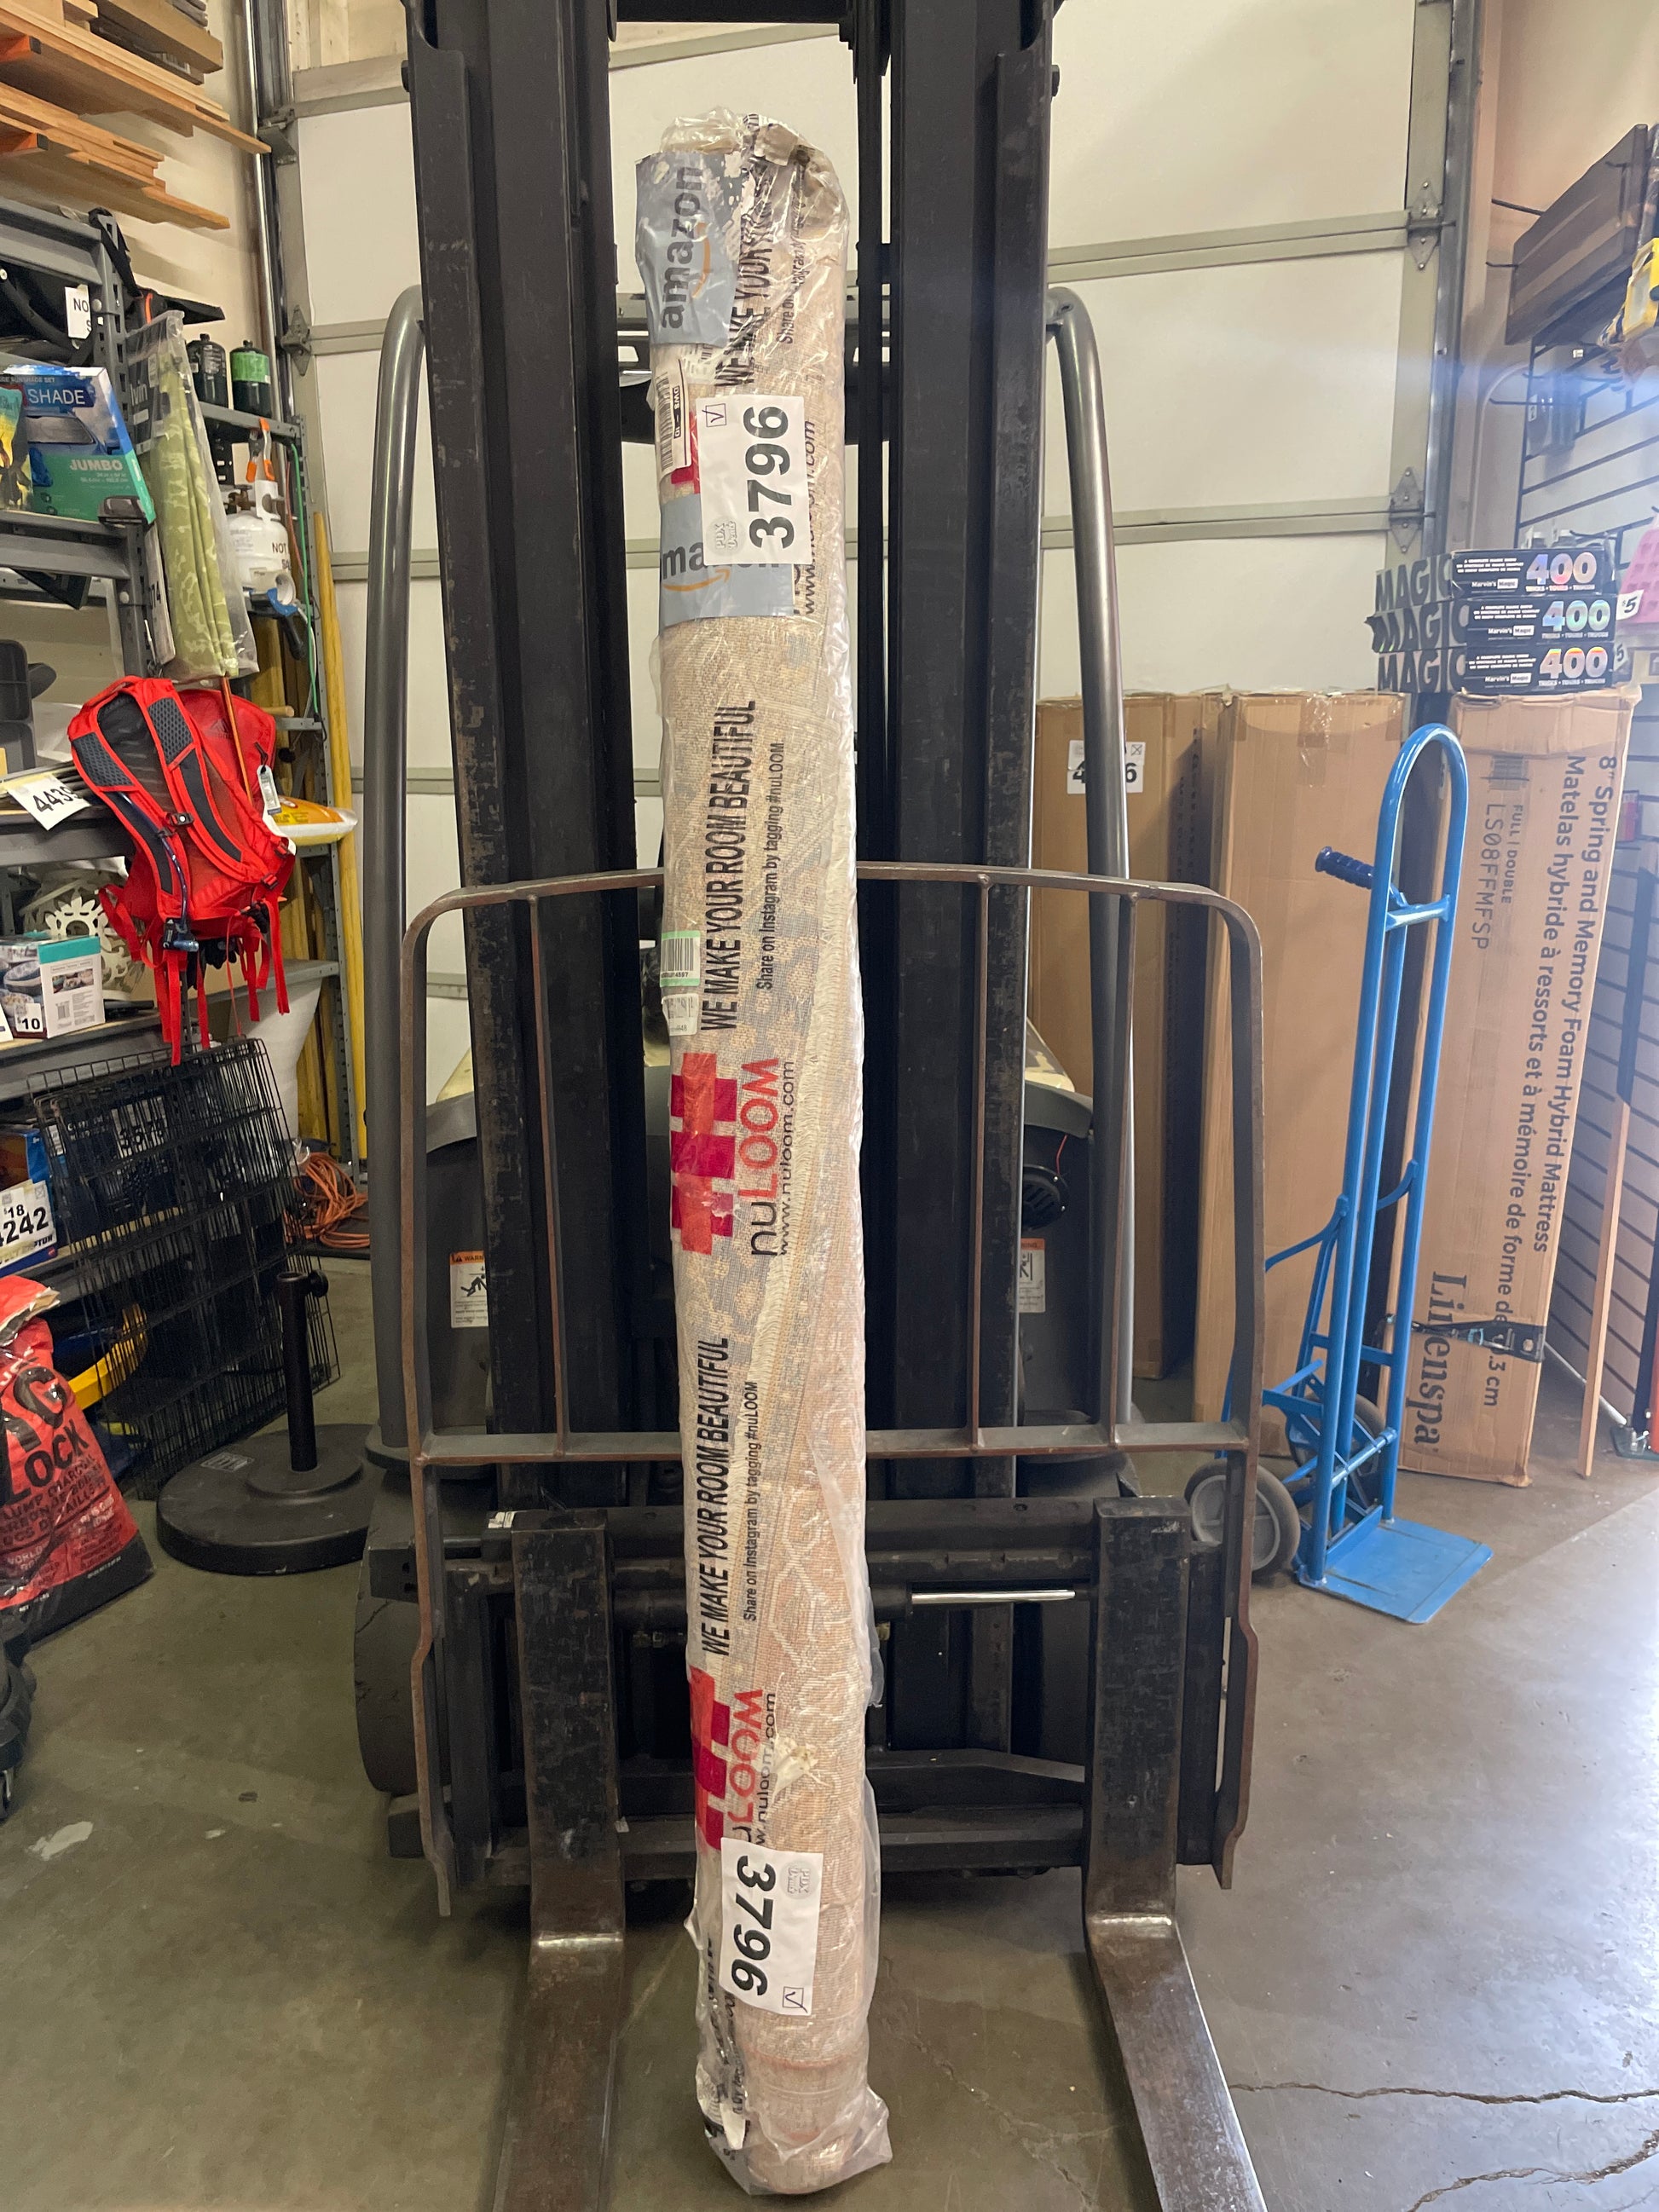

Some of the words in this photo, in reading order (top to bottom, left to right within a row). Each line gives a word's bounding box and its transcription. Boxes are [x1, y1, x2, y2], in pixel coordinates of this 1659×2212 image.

[662, 166, 703, 330] amazon
[28, 389, 85, 405] SHADE
[70, 459, 123, 471] JUMBO
[743, 407, 795, 549] 3796
[272, 542, 286, 553] NOT
[1526, 552, 1597, 585] 400
[1376, 555, 1451, 612] MAGIC
[1372, 602, 1470, 652] MAGIC
[1542, 599, 1610, 632] 400
[1378, 650, 1467, 693] MAGIC
[1540, 646, 1609, 679] 400
[709, 701, 755, 808] BEAUTIFUL
[766, 742, 784, 803] #nuLOOM
[1509, 805, 1523, 837] FULL
[1557, 756, 1586, 846] Matelas
[1581, 786, 1613, 863] Spring
[705, 815, 746, 873] ROOM
[764, 807, 783, 851] tagging
[763, 854, 781, 869] by
[1471, 804, 1507, 950] LS08FFMFSP
[1501, 849, 1517, 904] DOUBLE
[705, 880, 743, 933] YOUR
[760, 872, 781, 932] Instagram
[1543, 853, 1573, 940] hybride
[1580, 870, 1600, 912] and
[704, 939, 741, 994] MAKE
[761, 936, 775, 951] on
[1540, 946, 1561, 958] à
[1562, 921, 1595, 1013] Memory
[756, 955, 774, 990] Share
[701, 1001, 737, 1030] WE
[1528, 967, 1553, 1051] ressorts
[1525, 1059, 1542, 1078] et
[1557, 1018, 1581, 1078] Foam
[1523, 1085, 1541, 1096] à
[1546, 1085, 1573, 1156] Hybrid
[738, 1057, 779, 1256] nuLOOM
[779, 1060, 795, 1256] www.nuloom.com
[1508, 1103, 1537, 1198] mémoire
[1507, 1204, 1526, 1229] de
[1535, 1164, 1560, 1252] Mattress
[1497, 1236, 1521, 1295] forme
[697, 1338, 729, 1441] BEAUTIFUL
[744, 1381, 759, 1439] #nuLOOM
[1484, 1376, 1500, 1406] cm
[697, 1445, 730, 1505] ROOM
[744, 1442, 761, 1487] tagging
[744, 1490, 760, 1504] by
[697, 1508, 729, 1560] YOUR
[743, 1508, 760, 1568] Instagram
[699, 1563, 729, 1622] MAKE
[743, 1591, 757, 1621] Share
[748, 1572, 757, 1585] on
[702, 1622, 731, 1655] WE
[731, 1856, 776, 1996] 3796
